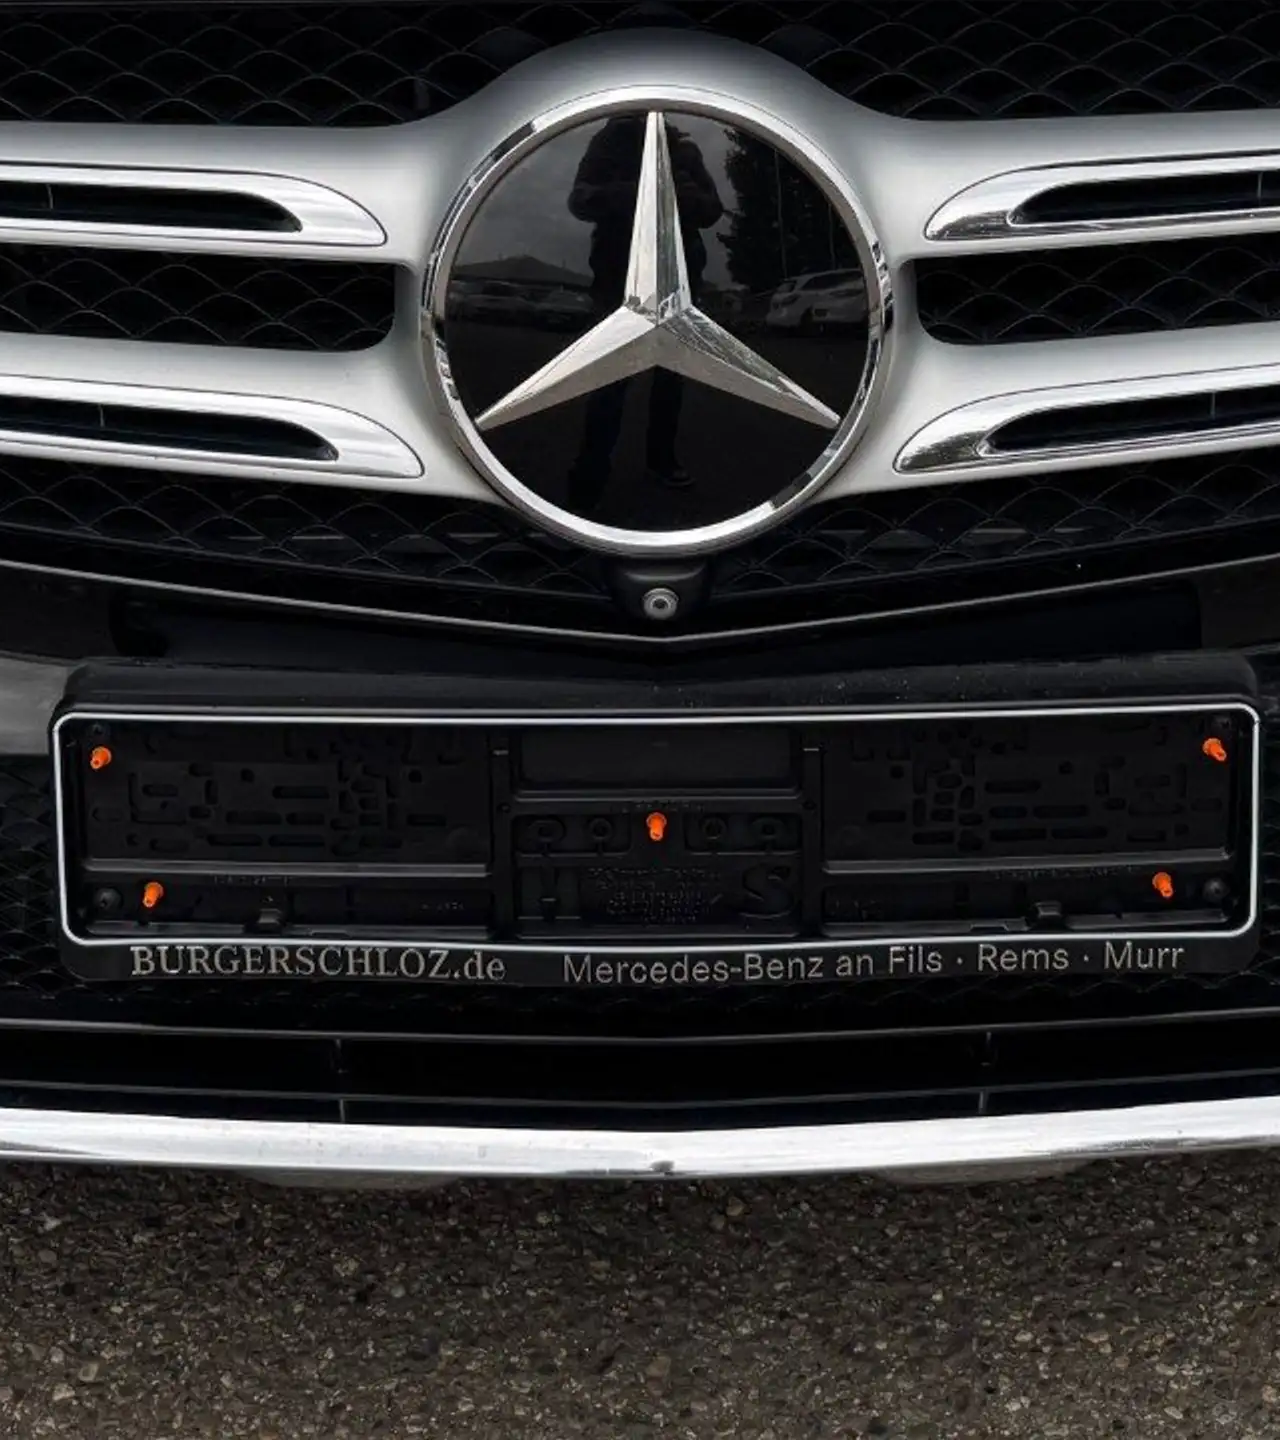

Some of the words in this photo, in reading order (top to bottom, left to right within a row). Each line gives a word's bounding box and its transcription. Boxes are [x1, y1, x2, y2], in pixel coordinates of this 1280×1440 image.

[130, 945, 506, 980] BURGERSCHLOZ.de
[563, 953, 824, 984] Mercedes-Benz
[835, 953, 874, 977] an
[888, 945, 943, 974] Fils
[977, 943, 1070, 972] Rems
[1104, 940, 1185, 970] Murr
